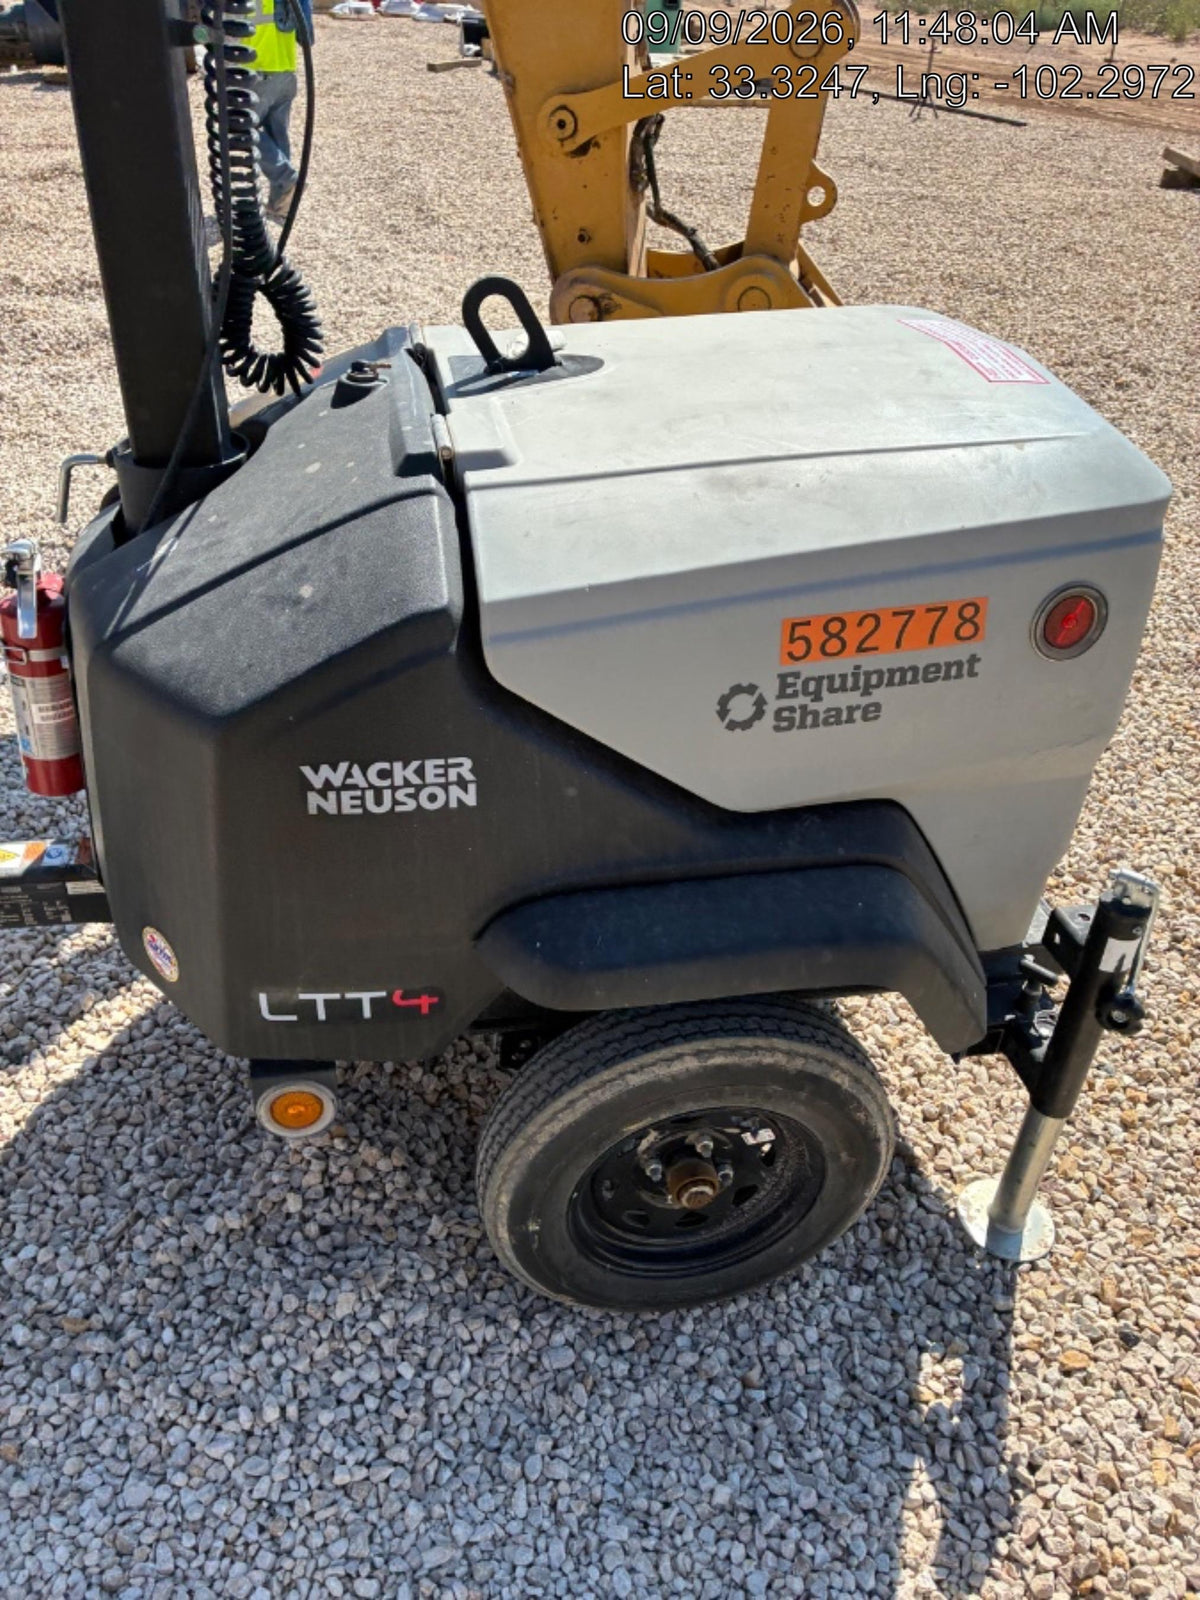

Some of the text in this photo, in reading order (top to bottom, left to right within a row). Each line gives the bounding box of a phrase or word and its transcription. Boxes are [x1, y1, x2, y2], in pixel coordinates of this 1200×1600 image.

[786, 601, 982, 663] 582778
[775, 653, 982, 703] Equipment
[772, 699, 882, 733] Share
[299, 756, 477, 790] WACKER
[306, 782, 478, 815] NEUSON
[258, 989, 440, 1022] LTT4
